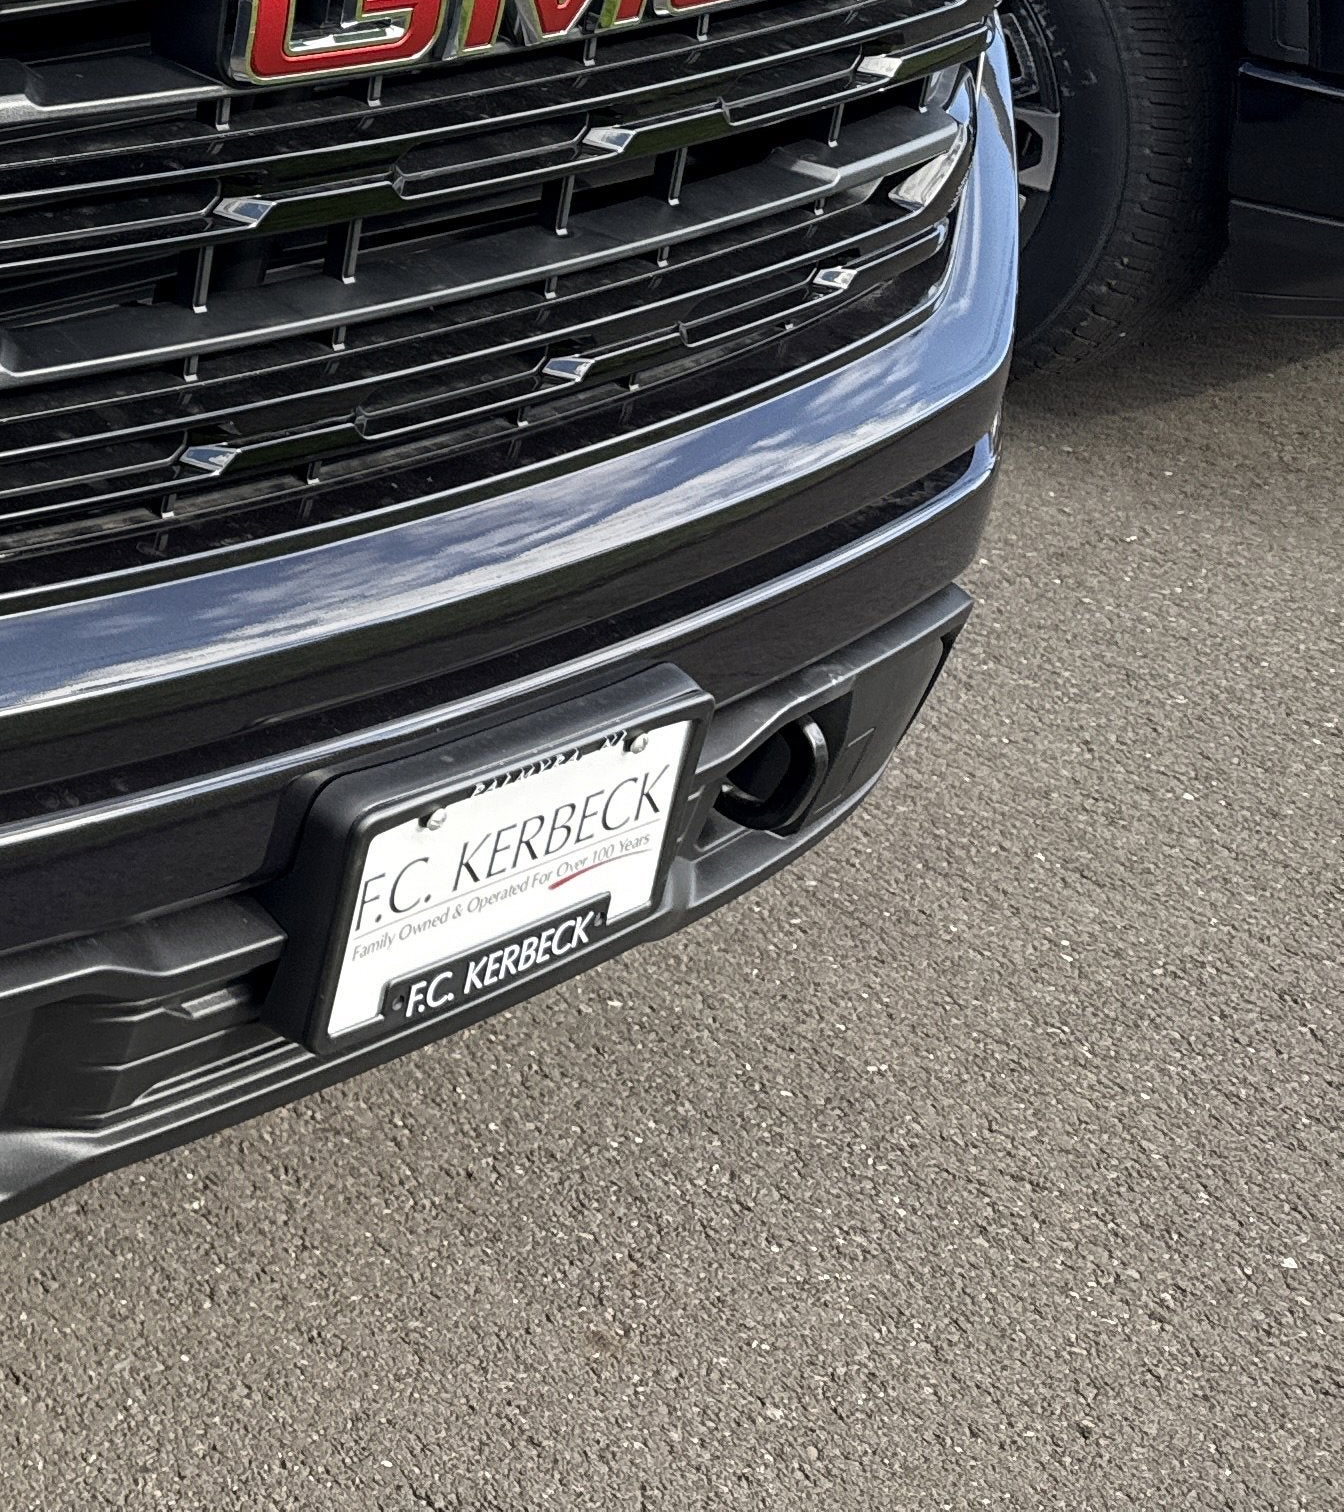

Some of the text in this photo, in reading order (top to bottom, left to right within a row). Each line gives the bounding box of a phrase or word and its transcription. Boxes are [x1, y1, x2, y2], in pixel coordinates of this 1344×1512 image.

[352, 834, 650, 961] Family Owned & Operated For Over 100 Years
[355, 764, 670, 932] F.C. KERBECK
[406, 910, 595, 1018] F.C. KERBECK
